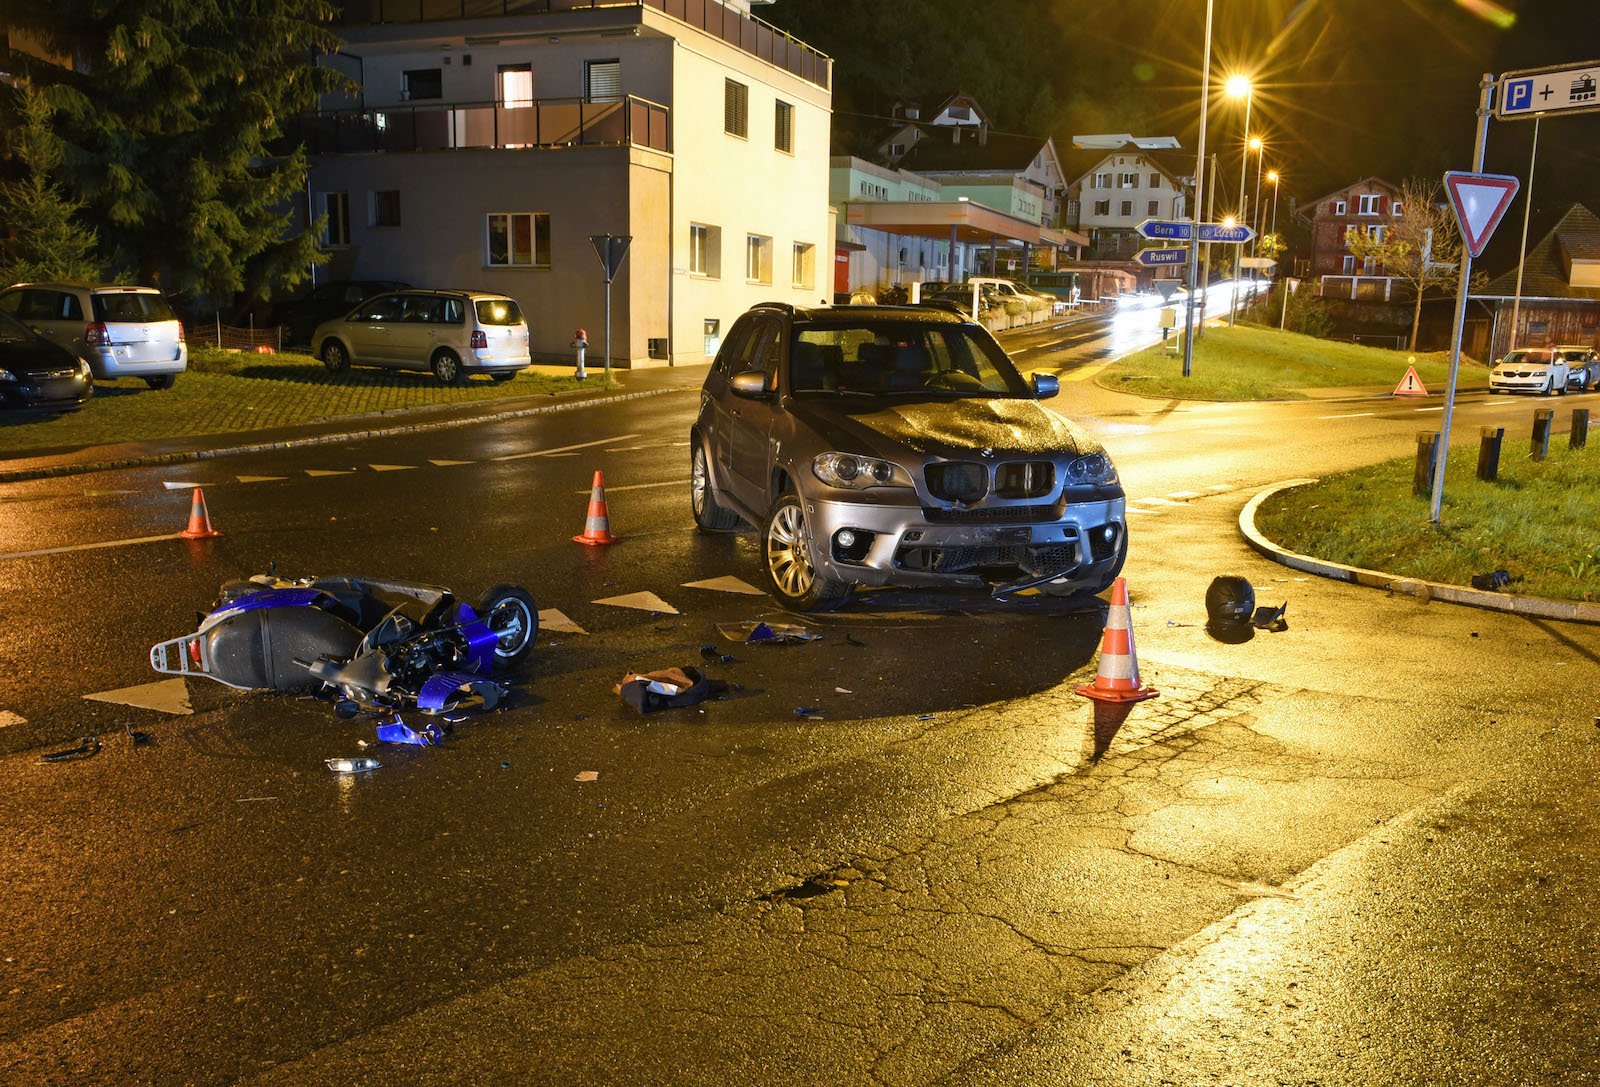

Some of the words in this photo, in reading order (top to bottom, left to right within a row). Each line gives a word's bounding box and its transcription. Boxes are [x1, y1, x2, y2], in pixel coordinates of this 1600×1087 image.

[1512, 84, 1527, 107] P
[1154, 225, 1174, 234] Bern
[1181, 228, 1188, 236] 10
[1202, 229, 1209, 237] 10
[1214, 229, 1243, 238] Luzern
[1150, 252, 1177, 261] Ruswil
